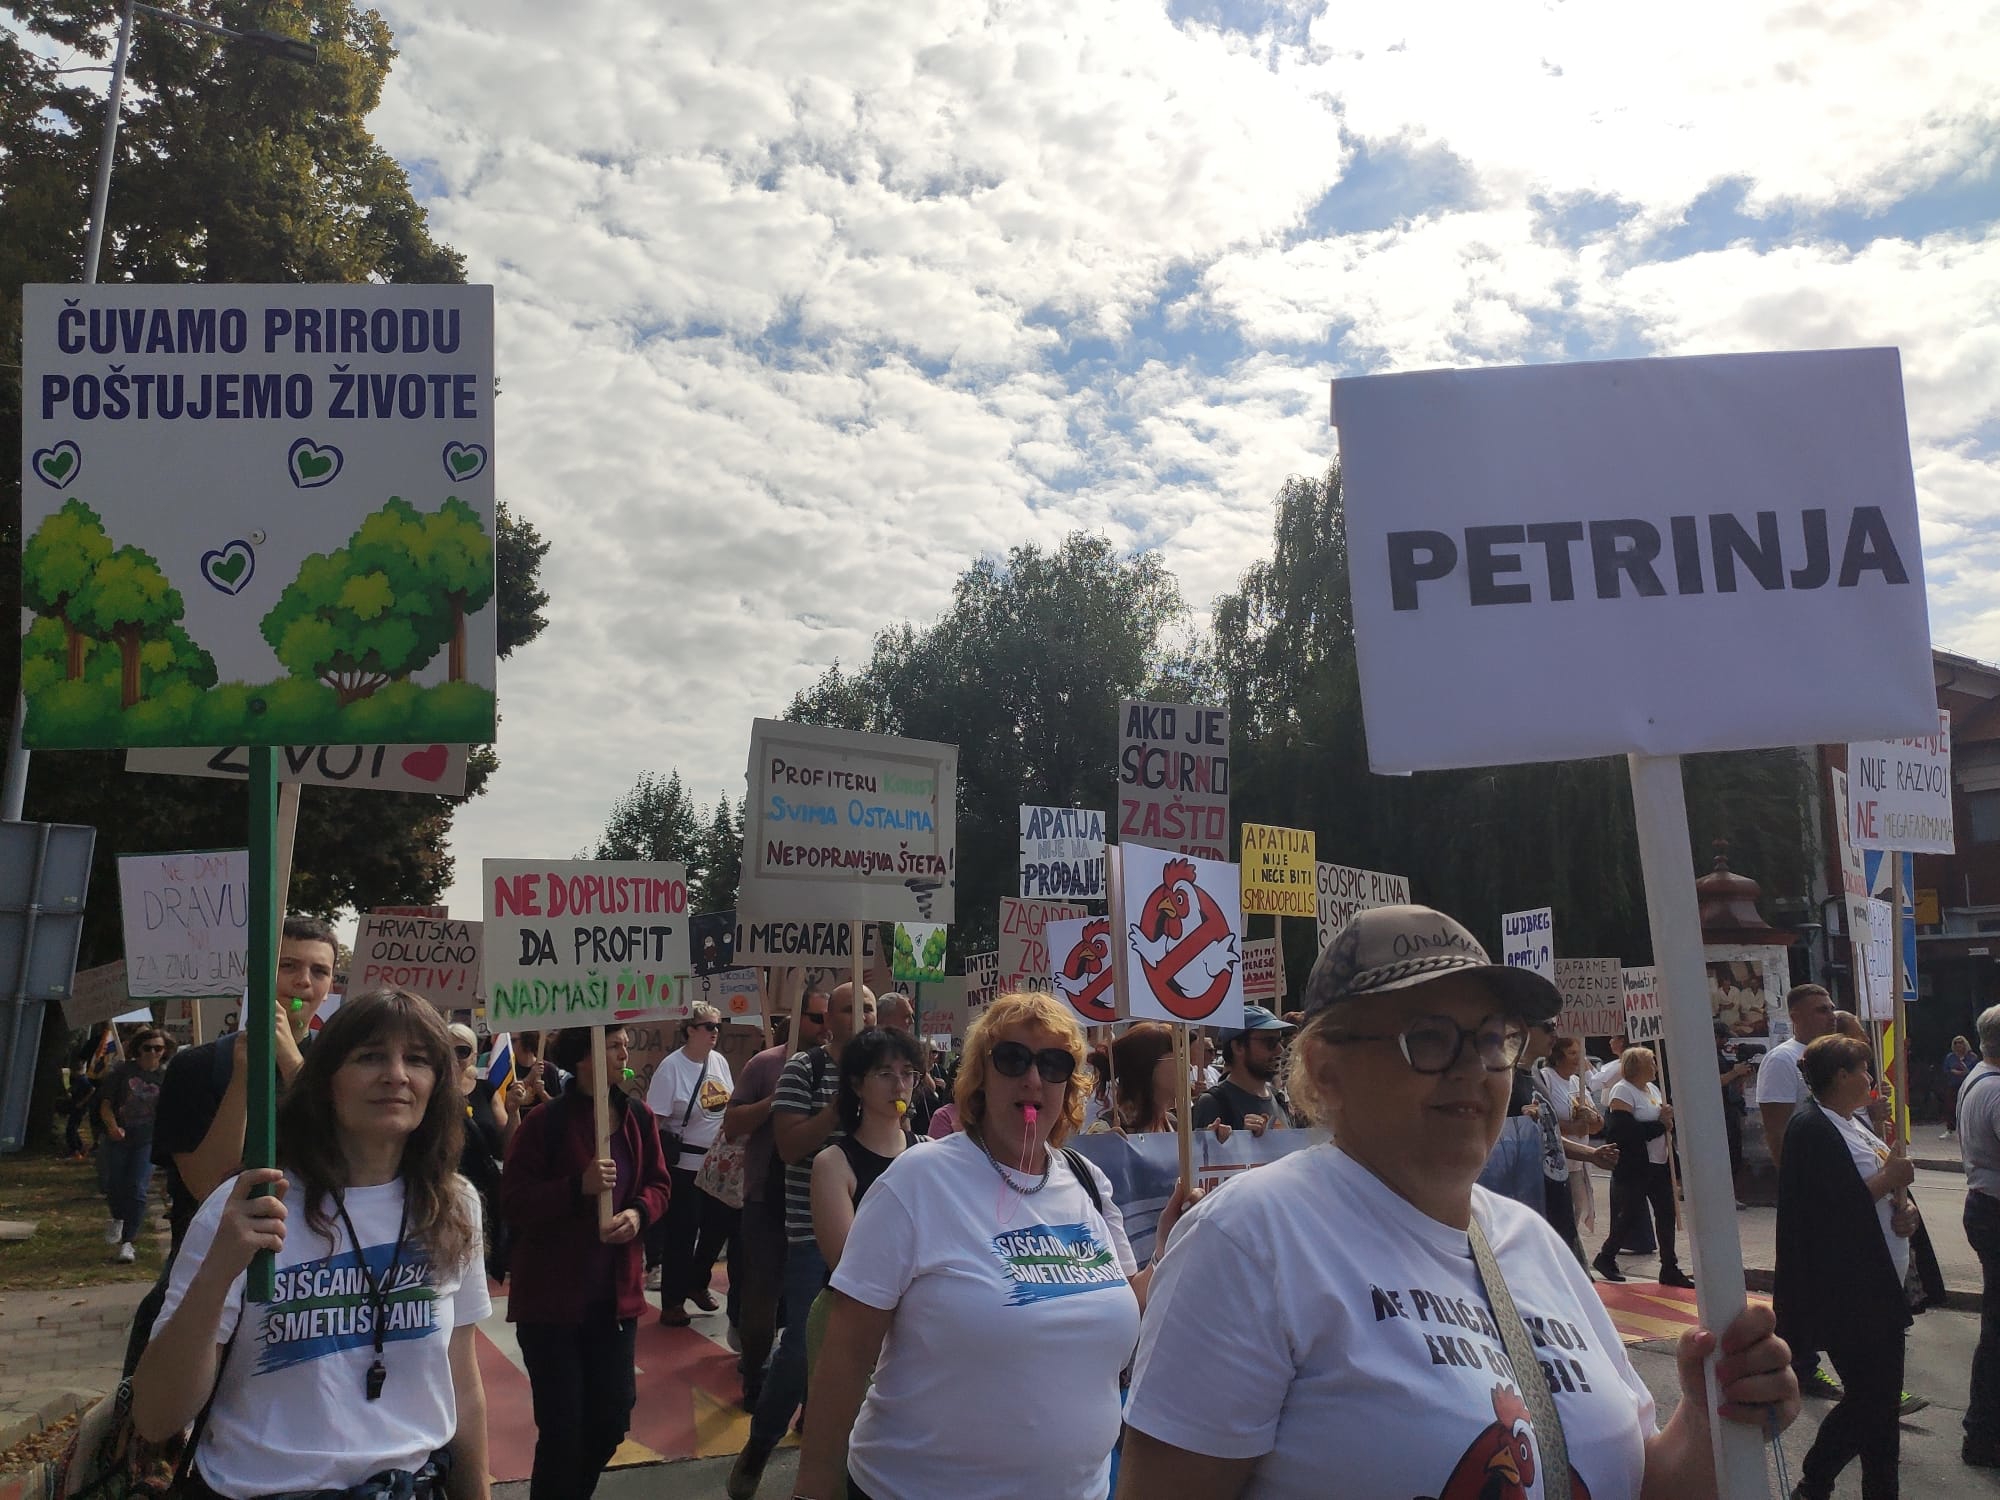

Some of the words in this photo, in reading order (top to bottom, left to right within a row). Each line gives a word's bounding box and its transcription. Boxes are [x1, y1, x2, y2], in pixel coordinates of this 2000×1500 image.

[57, 298, 248, 354] ČUVAMO
[264, 308, 461, 354] PRIRODU
[41, 364, 314, 420] POŠTUJEMO
[327, 364, 478, 420] ŽIVOTE
[1386, 505, 1910, 612] PETRINJA
[1126, 705, 1176, 740] AKO
[1185, 710, 1225, 746] JE
[770, 758, 877, 793] PROFITERU
[1121, 741, 1229, 795] SIGURNO
[1860, 757, 1887, 792] NIJE
[1896, 760, 1947, 798] RAZVOJ
[768, 795, 839, 825] SVIMA
[847, 799, 934, 832] OSTALIMA
[1025, 807, 1103, 842] APATIJA
[1120, 794, 1226, 840] ZAŠTO
[1856, 800, 1879, 839] NE
[1244, 826, 1310, 854] APATIJA
[1023, 857, 1105, 897] PRODAJU!
[1261, 865, 1285, 884] NEĆE
[1289, 871, 1311, 885] BITI
[1262, 853, 1288, 866] NIJE
[494, 873, 541, 918] NE
[546, 872, 688, 919] DOPUSTIMO
[1242, 888, 1315, 913] SMRADOPOLIS
[1317, 865, 1367, 900] GOSPIĆ
[1371, 876, 1406, 904] PLIVA
[143, 882, 248, 930] DRAVU
[1318, 898, 1327, 926] U
[1505, 912, 1549, 936] LUDBREG
[366, 919, 470, 942] HRVATSKA
[518, 927, 558, 967] DA
[574, 925, 673, 966] PROFIT
[208, 950, 248, 980] GLAV
[371, 941, 476, 964] ODLUČNO
[1507, 945, 1549, 970] APATIJA
[491, 970, 609, 1020] NADMAŠI
[1556, 975, 1618, 990] VOŽENJE
[1565, 993, 1605, 1008] PADA
[1625, 992, 1660, 1011] APATI
[1556, 1009, 1624, 1034] ATAKLIZMA
[1369, 1283, 1409, 1321] NE
[1423, 1332, 1483, 1370] EKO
